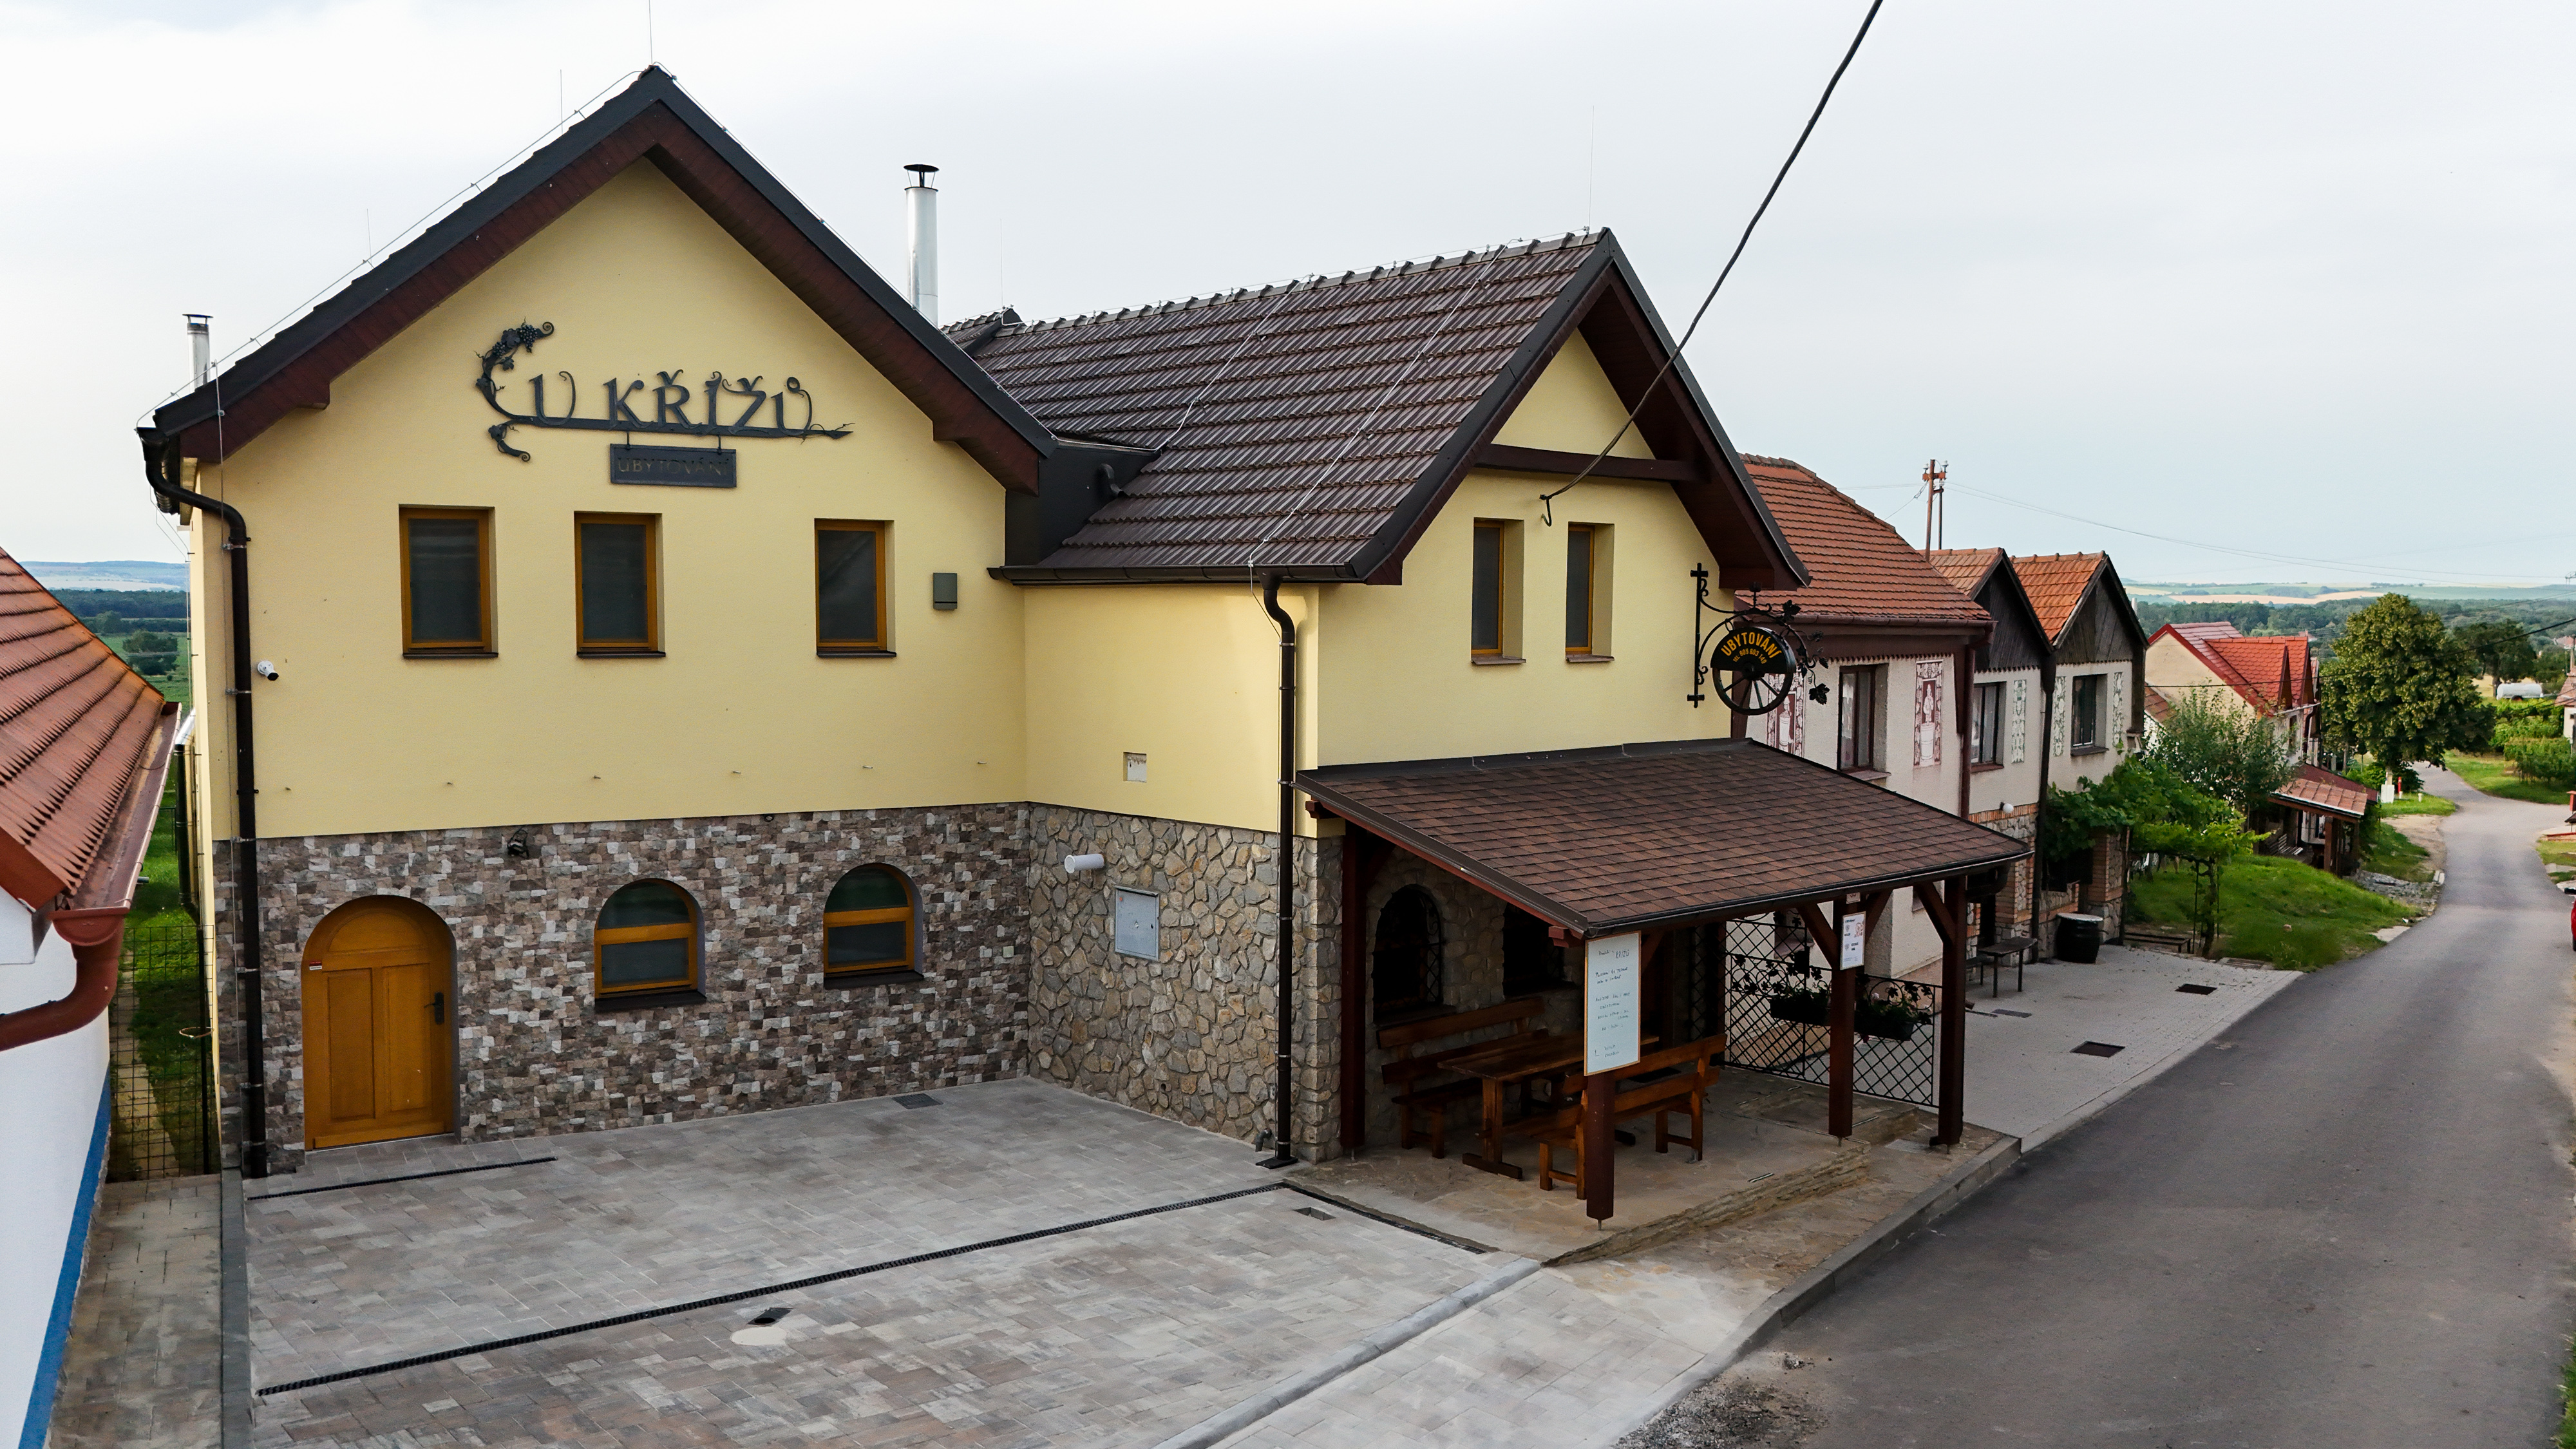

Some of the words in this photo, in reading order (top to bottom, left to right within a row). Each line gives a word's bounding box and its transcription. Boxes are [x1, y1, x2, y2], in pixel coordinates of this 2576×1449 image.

[529, 371, 576, 426] U
[603, 369, 813, 436] KŘÍŽŮ
[618, 457, 730, 476] UBYTOVÁNÍ
[1721, 632, 1782, 658] UBYTOVÁNÍ
